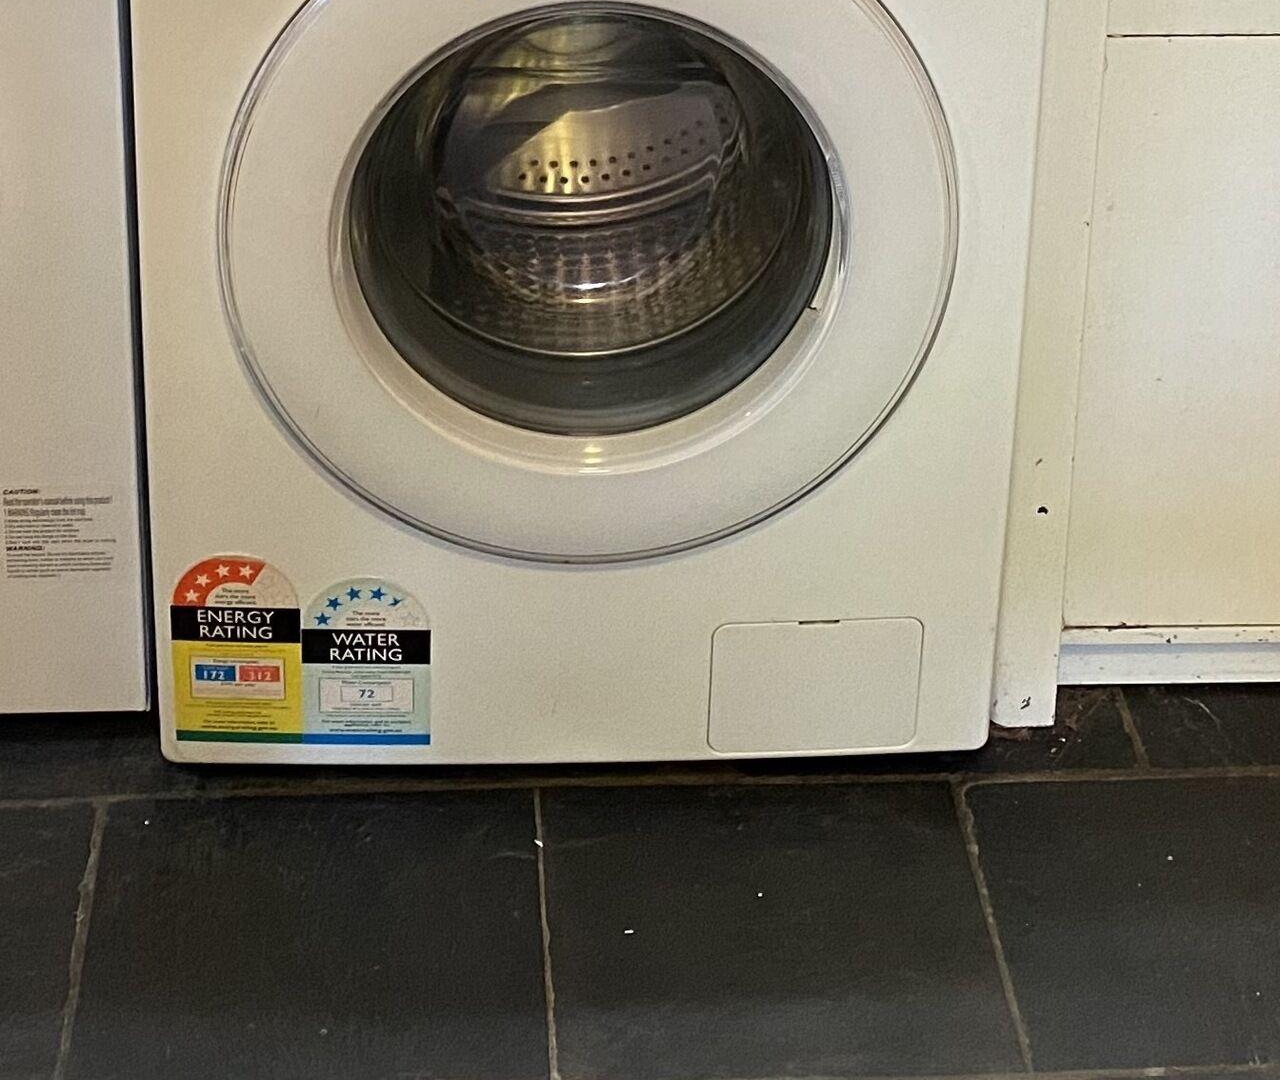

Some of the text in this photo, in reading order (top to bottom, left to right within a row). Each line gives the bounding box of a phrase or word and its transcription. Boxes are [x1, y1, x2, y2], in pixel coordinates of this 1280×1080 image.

[197, 609, 274, 624] ENERGY
[199, 624, 273, 640] RATING
[332, 632, 400, 646] WATER
[329, 648, 403, 661] RATING
[203, 670, 225, 680] 172
[359, 689, 375, 698] 72
